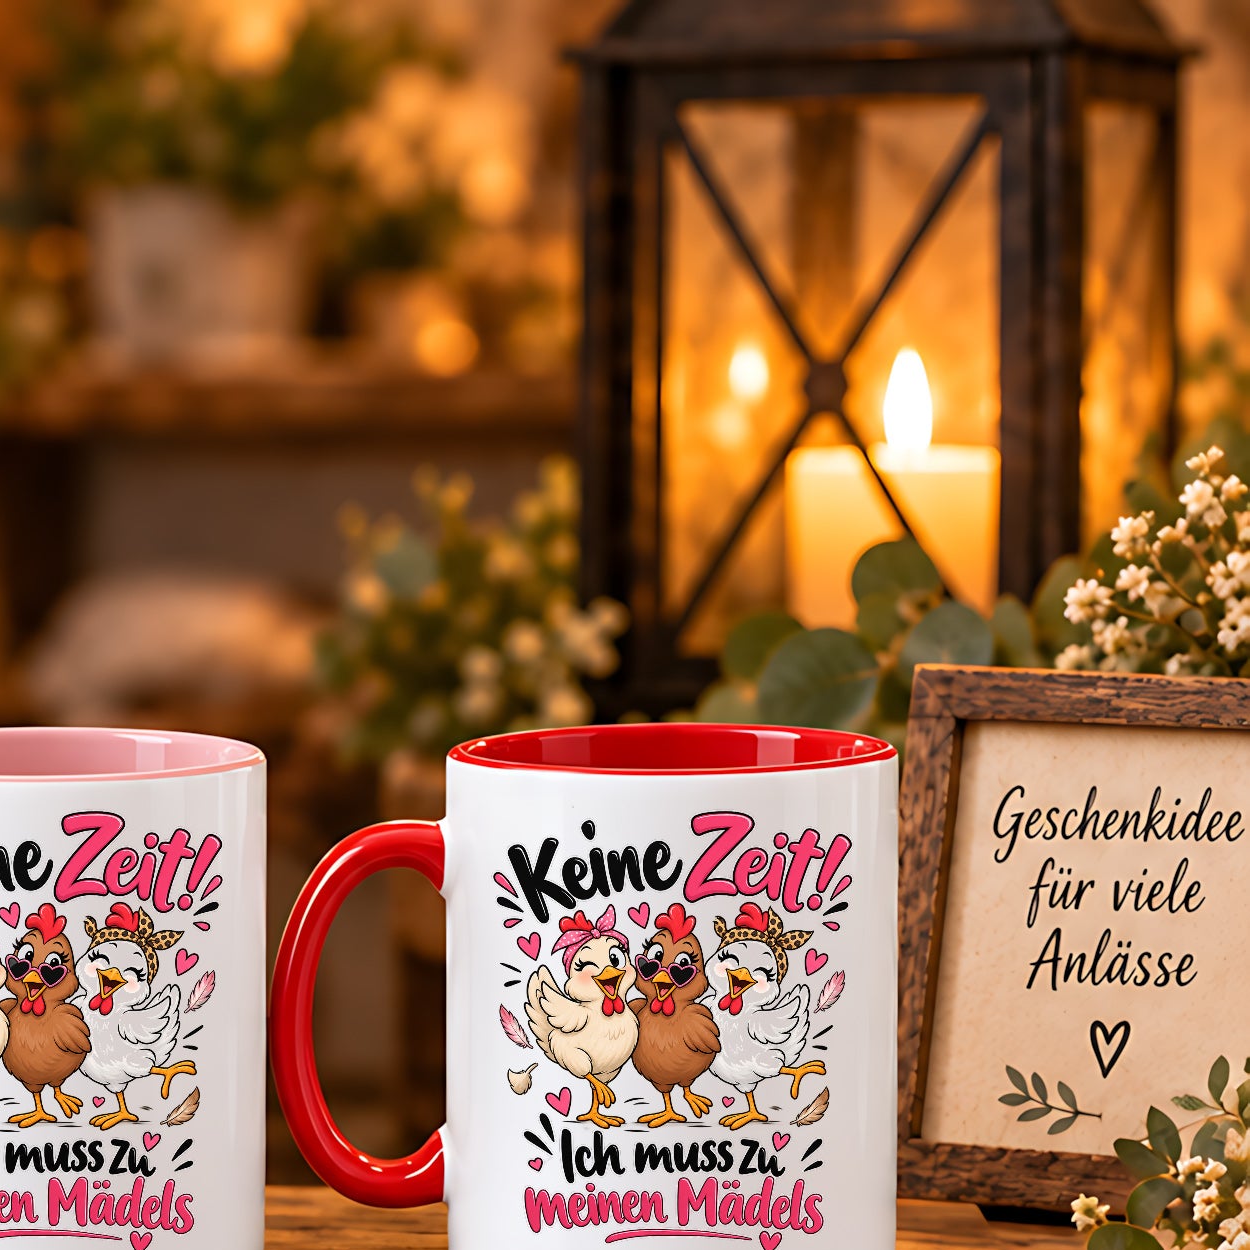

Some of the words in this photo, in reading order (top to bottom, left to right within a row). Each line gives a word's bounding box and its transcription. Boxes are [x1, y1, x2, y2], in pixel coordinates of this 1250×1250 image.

[993, 785, 1245, 864] Geschenkidee
[53, 811, 222, 913] Zeit!
[507, 820, 682, 923] Keine
[682, 811, 851, 913] Zeit!
[1026, 857, 1095, 929] für
[1113, 857, 1206, 914] viele
[1026, 927, 1198, 992] Anlässe
[6, 1140, 105, 1175] muss
[559, 1129, 624, 1183] Ich
[635, 1140, 734, 1175] muss
[48, 1177, 194, 1234] Mädels
[524, 1184, 668, 1233] meinen
[677, 1177, 823, 1234] Mädels
